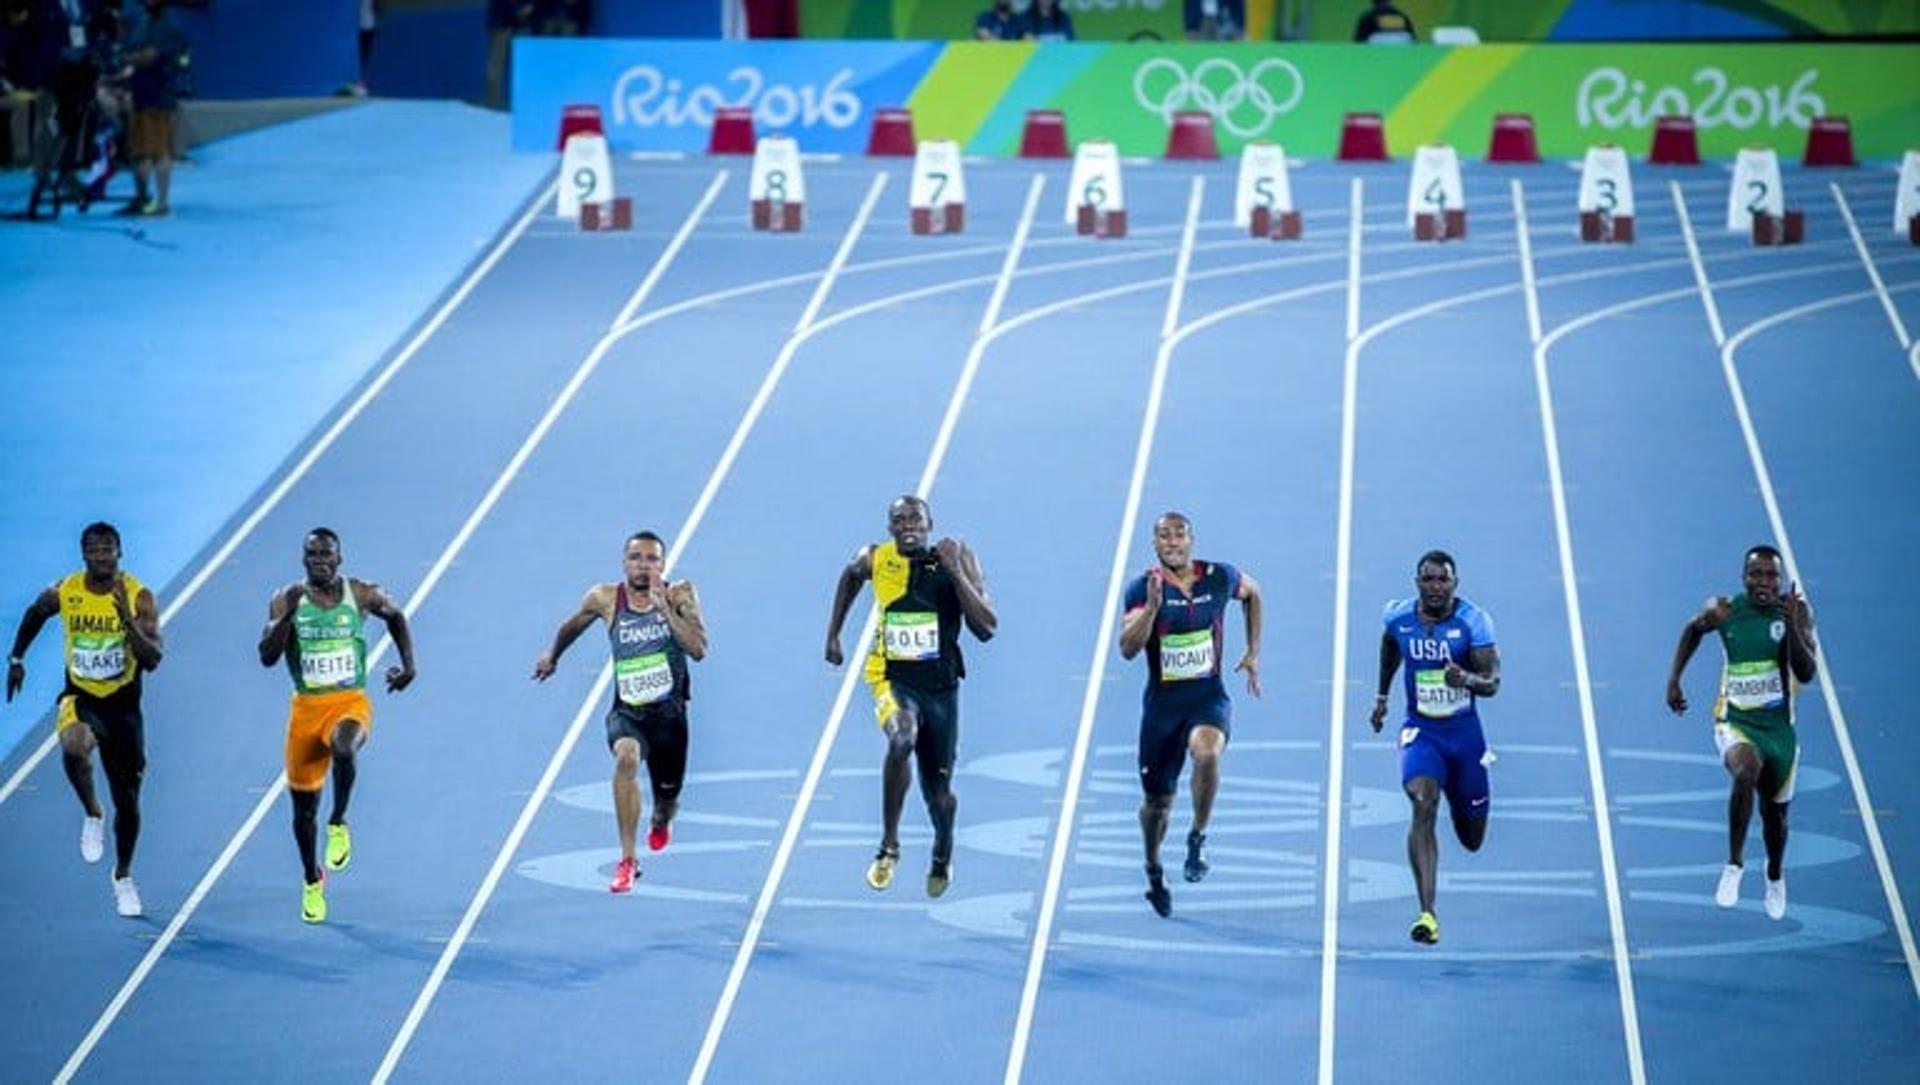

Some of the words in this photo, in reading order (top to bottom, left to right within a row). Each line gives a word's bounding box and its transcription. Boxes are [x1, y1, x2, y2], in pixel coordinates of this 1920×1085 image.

[574, 167, 597, 200] 9
[764, 169, 787, 203] 8
[926, 172, 948, 203] 7
[1084, 176, 1107, 206] 6
[1254, 177, 1276, 208] 5
[1424, 178, 1447, 212] 4
[1595, 180, 1618, 212] 3
[1746, 182, 1769, 213] 2
[886, 629, 937, 649] BOLT
[1409, 638, 1451, 662] USA
[72, 651, 125, 671] BLAKE
